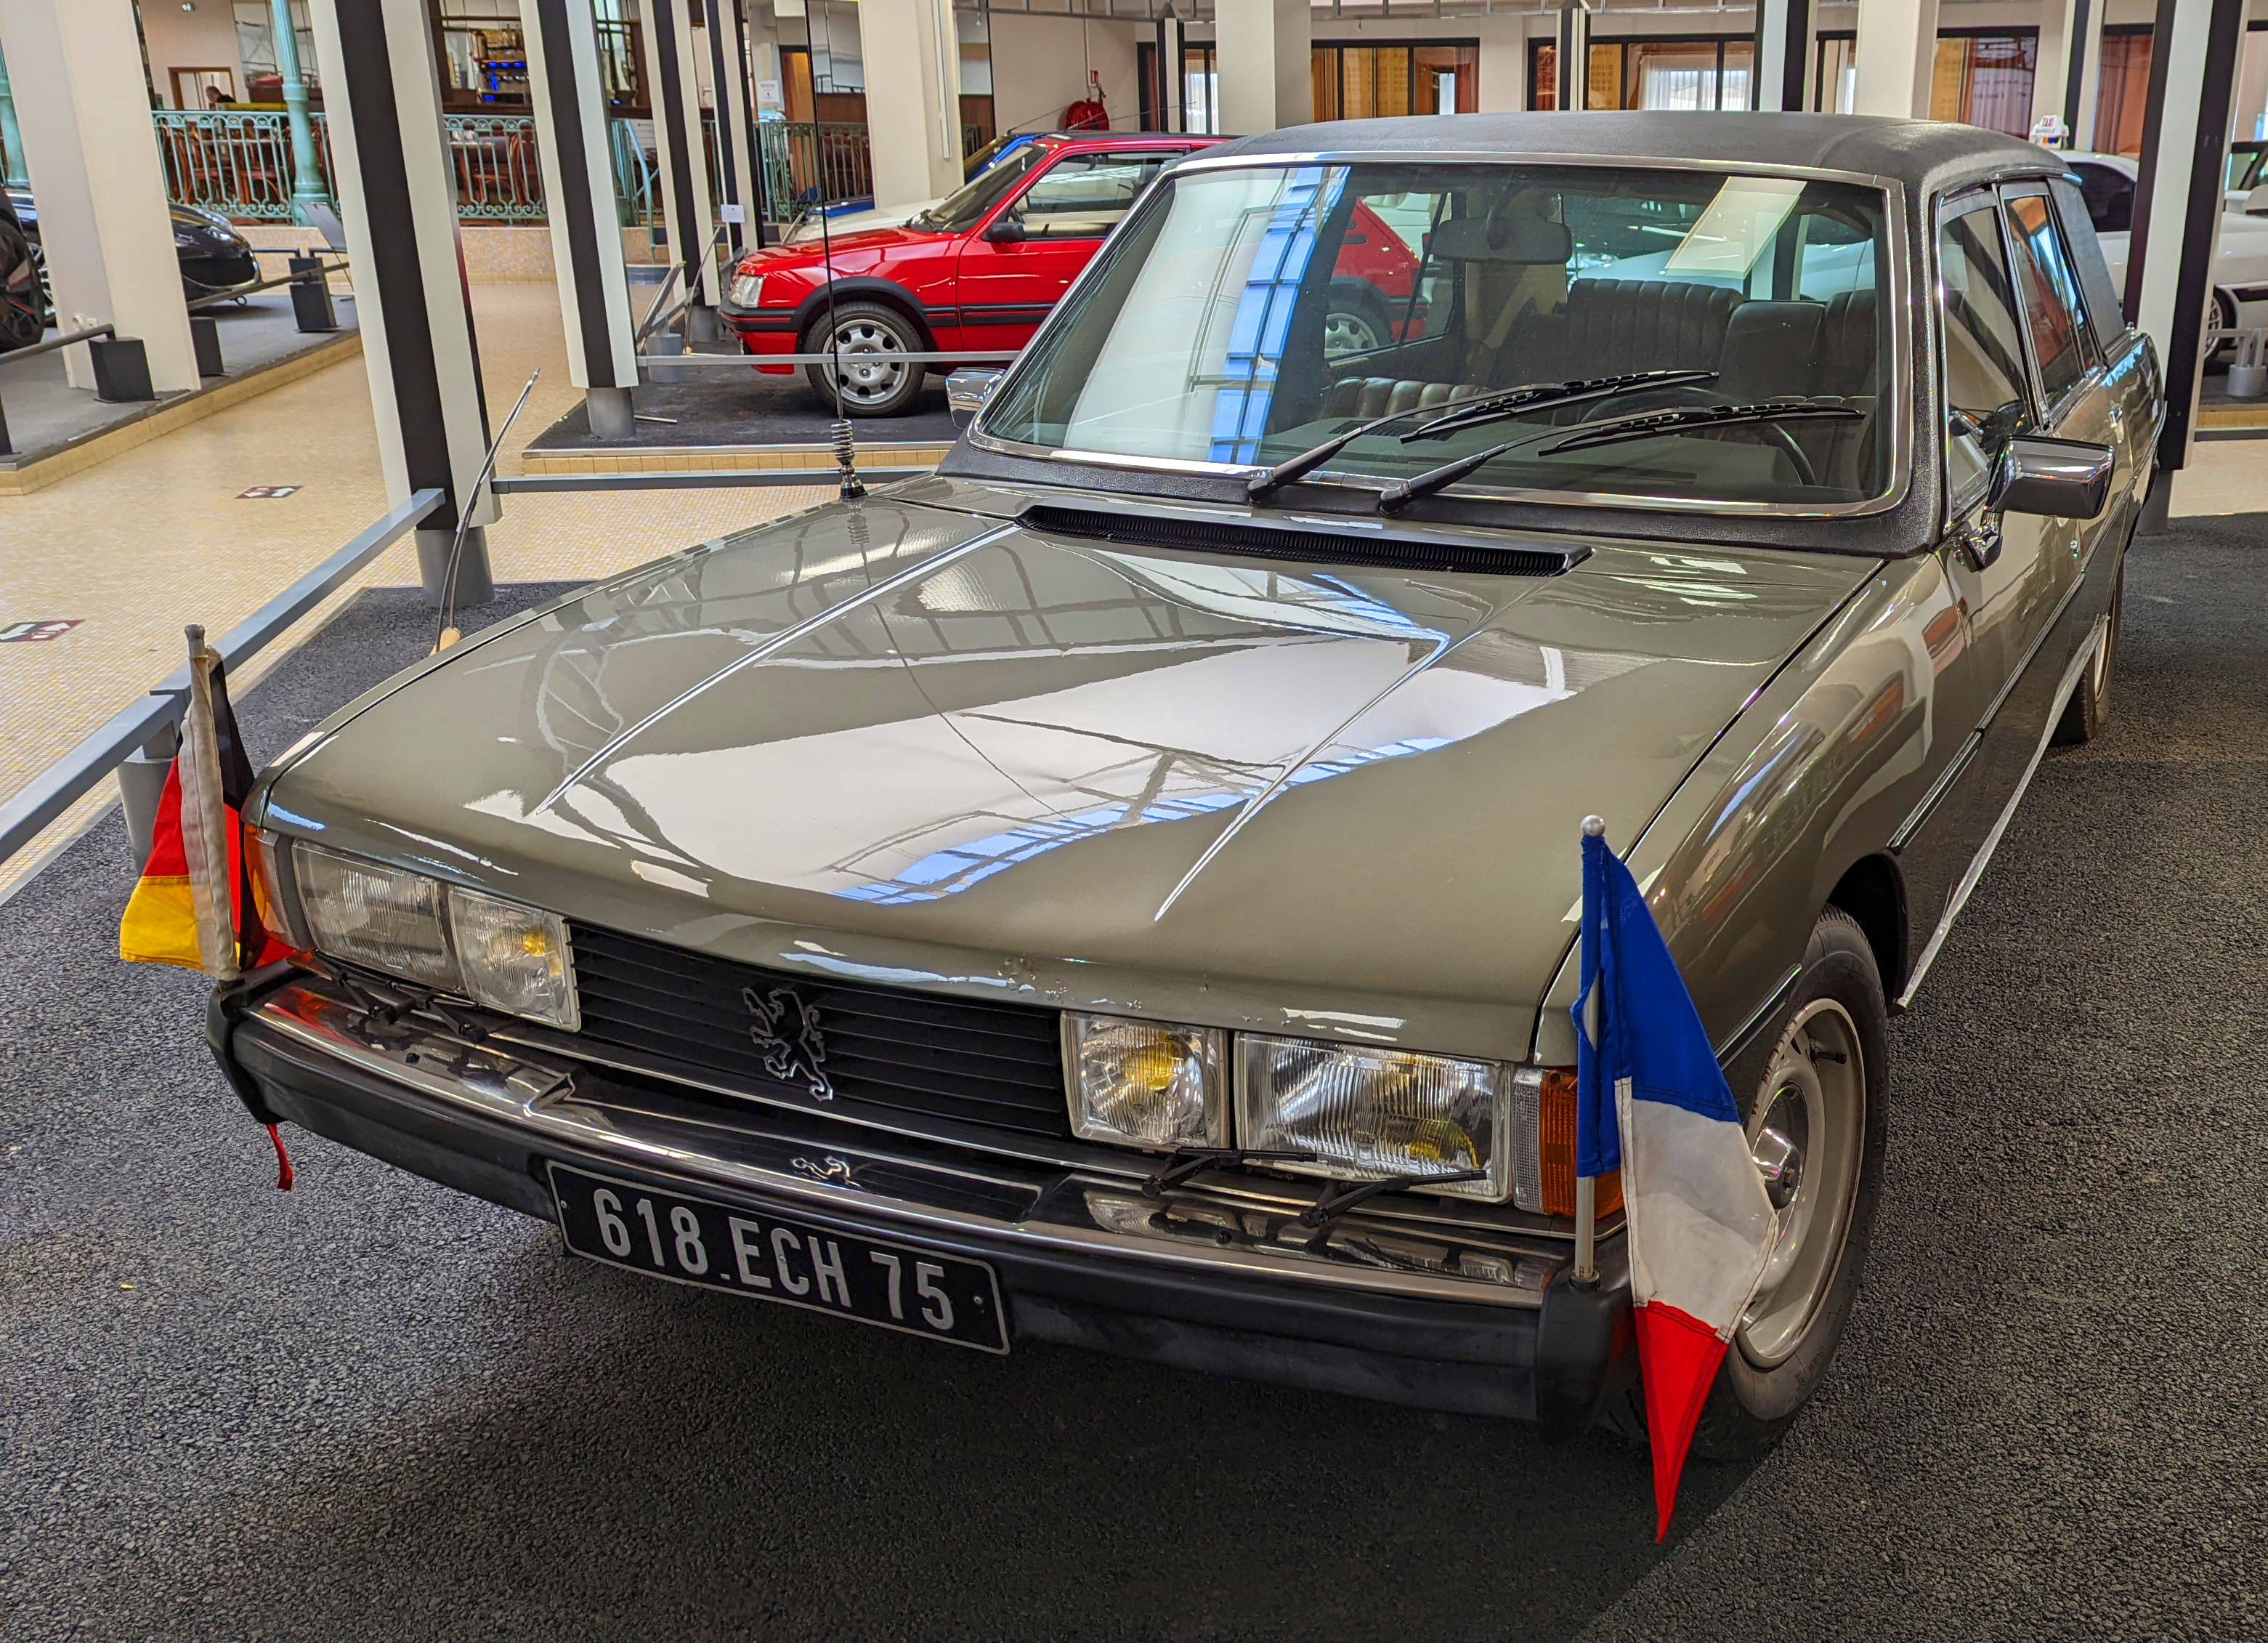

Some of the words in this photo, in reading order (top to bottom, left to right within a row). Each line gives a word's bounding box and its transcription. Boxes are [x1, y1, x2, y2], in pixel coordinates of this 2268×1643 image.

[2042, 118, 2054, 126] TAXI
[593, 1188, 708, 1275] 618
[729, 1216, 852, 1307] ECH
[870, 1251, 954, 1331] 75
